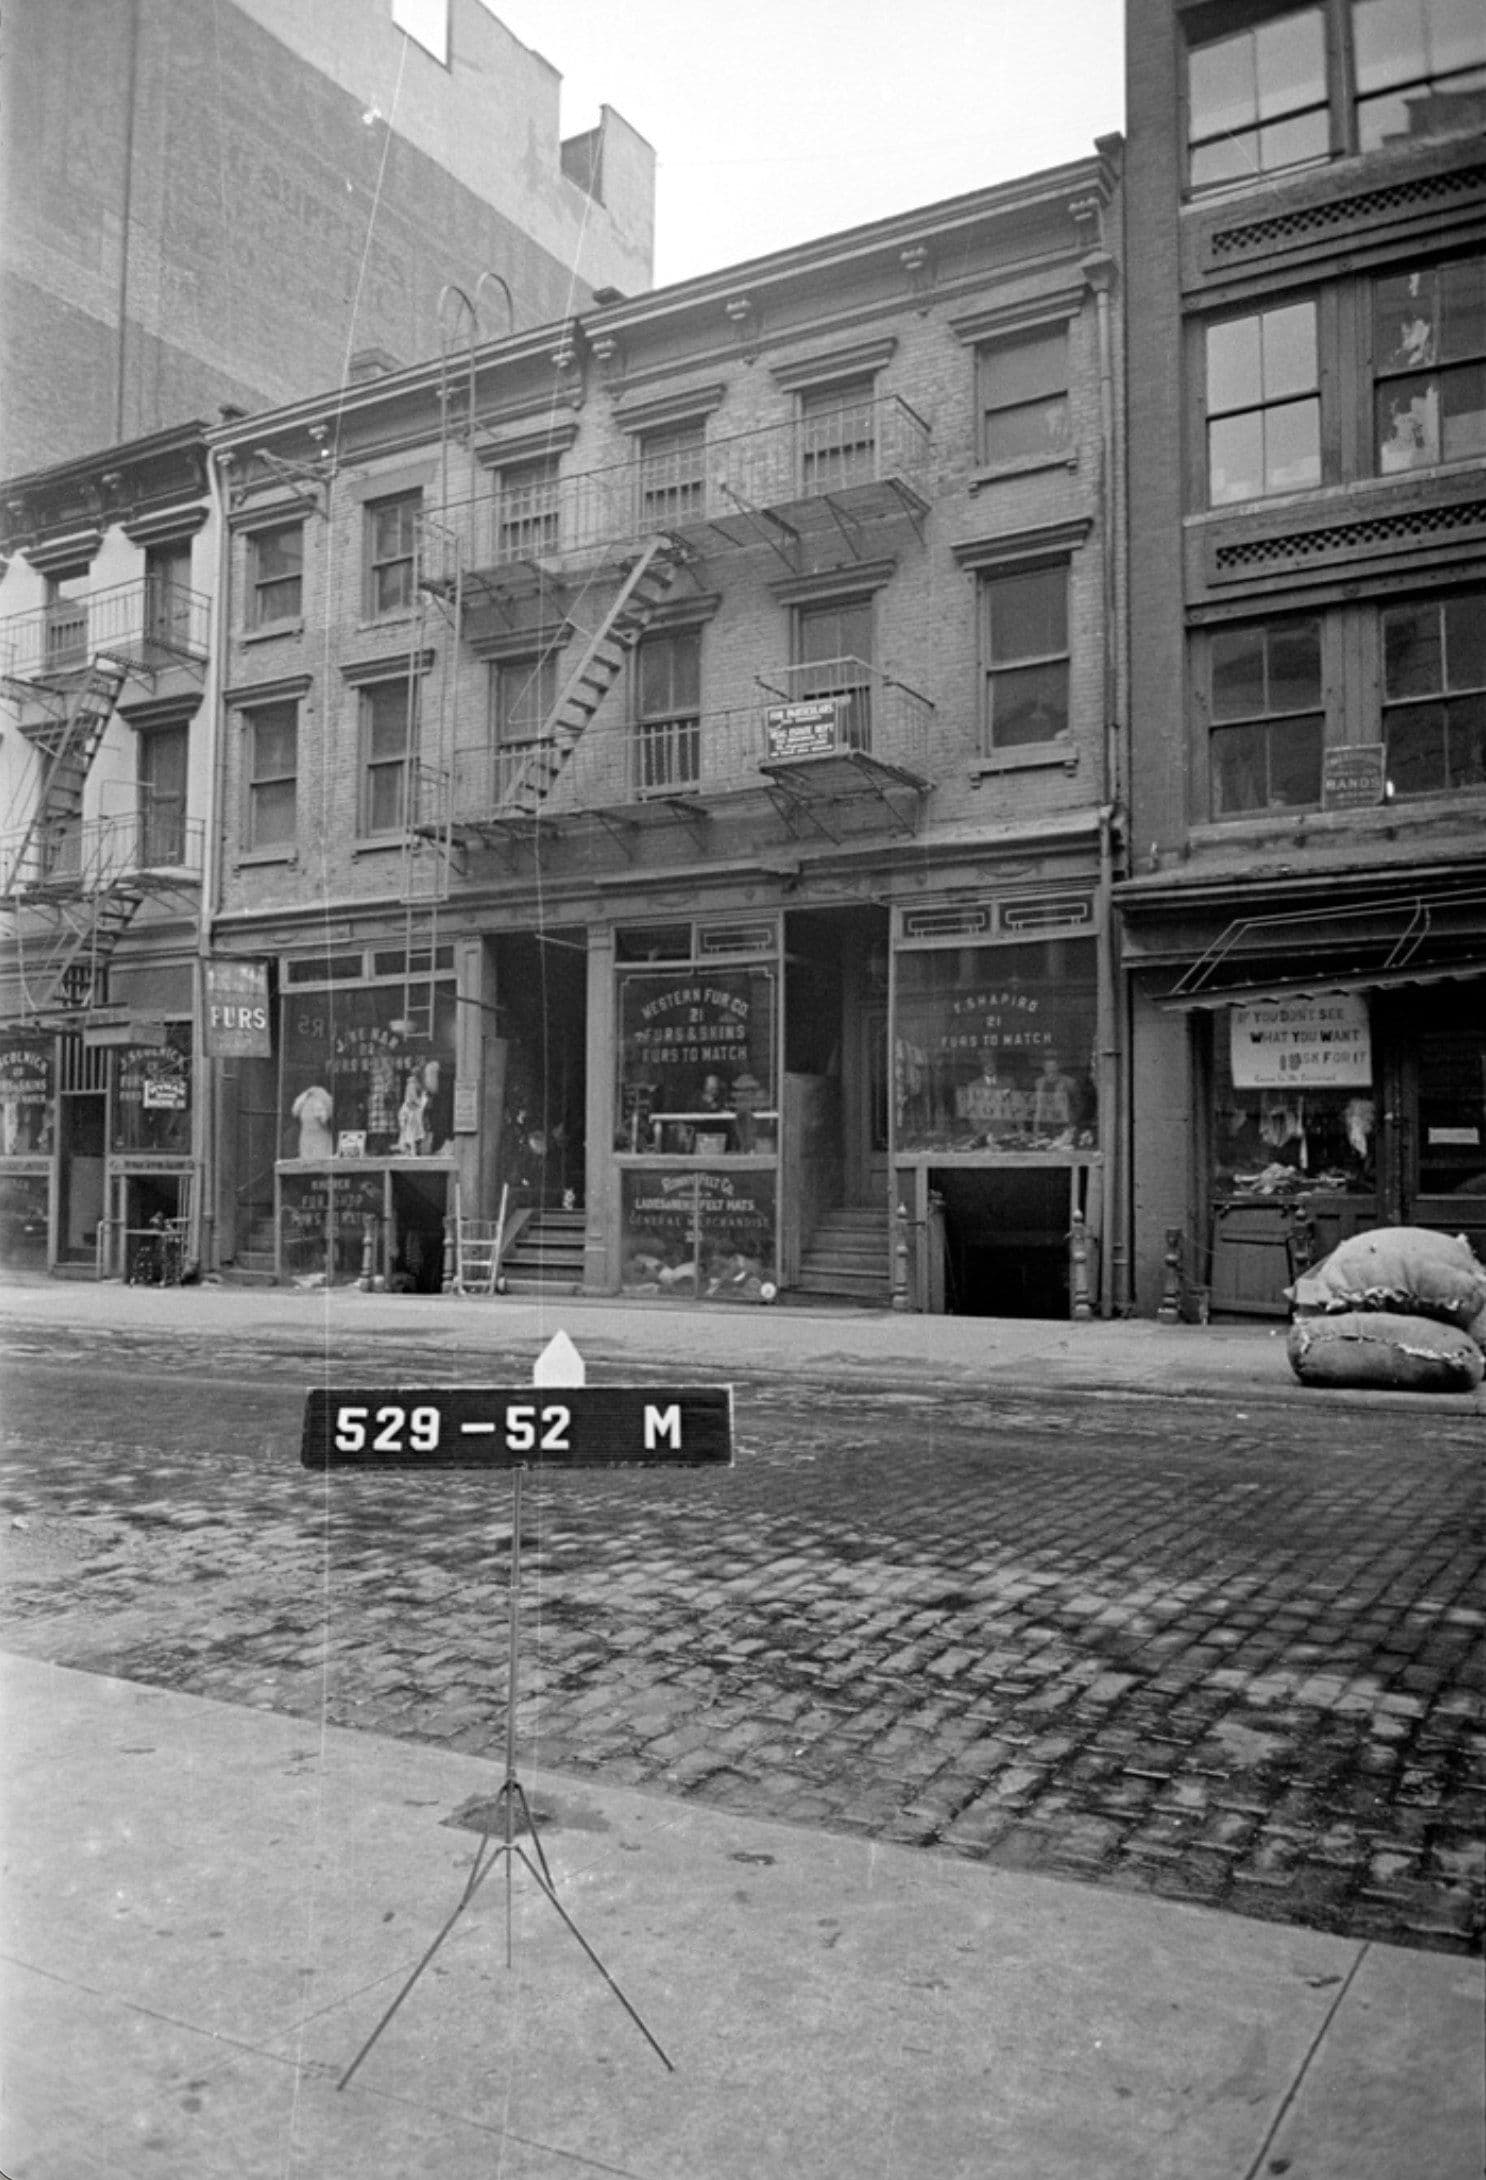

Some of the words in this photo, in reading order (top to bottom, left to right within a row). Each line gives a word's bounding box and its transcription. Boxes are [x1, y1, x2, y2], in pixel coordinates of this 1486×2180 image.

[641, 988, 701, 1019] WESTERN
[704, 988, 730, 1008] FUR
[210, 1005, 266, 1029] FURS
[986, 1015, 1001, 1027] 21
[1254, 1009, 1279, 1023] YOU
[1319, 1007, 1345, 1020] SEE
[941, 1034, 978, 1048] FURS
[983, 1033, 998, 1046] TO
[1003, 1032, 1051, 1046] MATCH
[1250, 1031, 1289, 1044] WHAT
[1292, 1030, 1317, 1043] YOU
[1320, 1029, 1360, 1042] WANT
[682, 1047, 698, 1062] TO
[701, 1046, 747, 1062] MATCH
[1322, 1051, 1351, 1064] FOR
[643, 1404, 681, 1450] M
